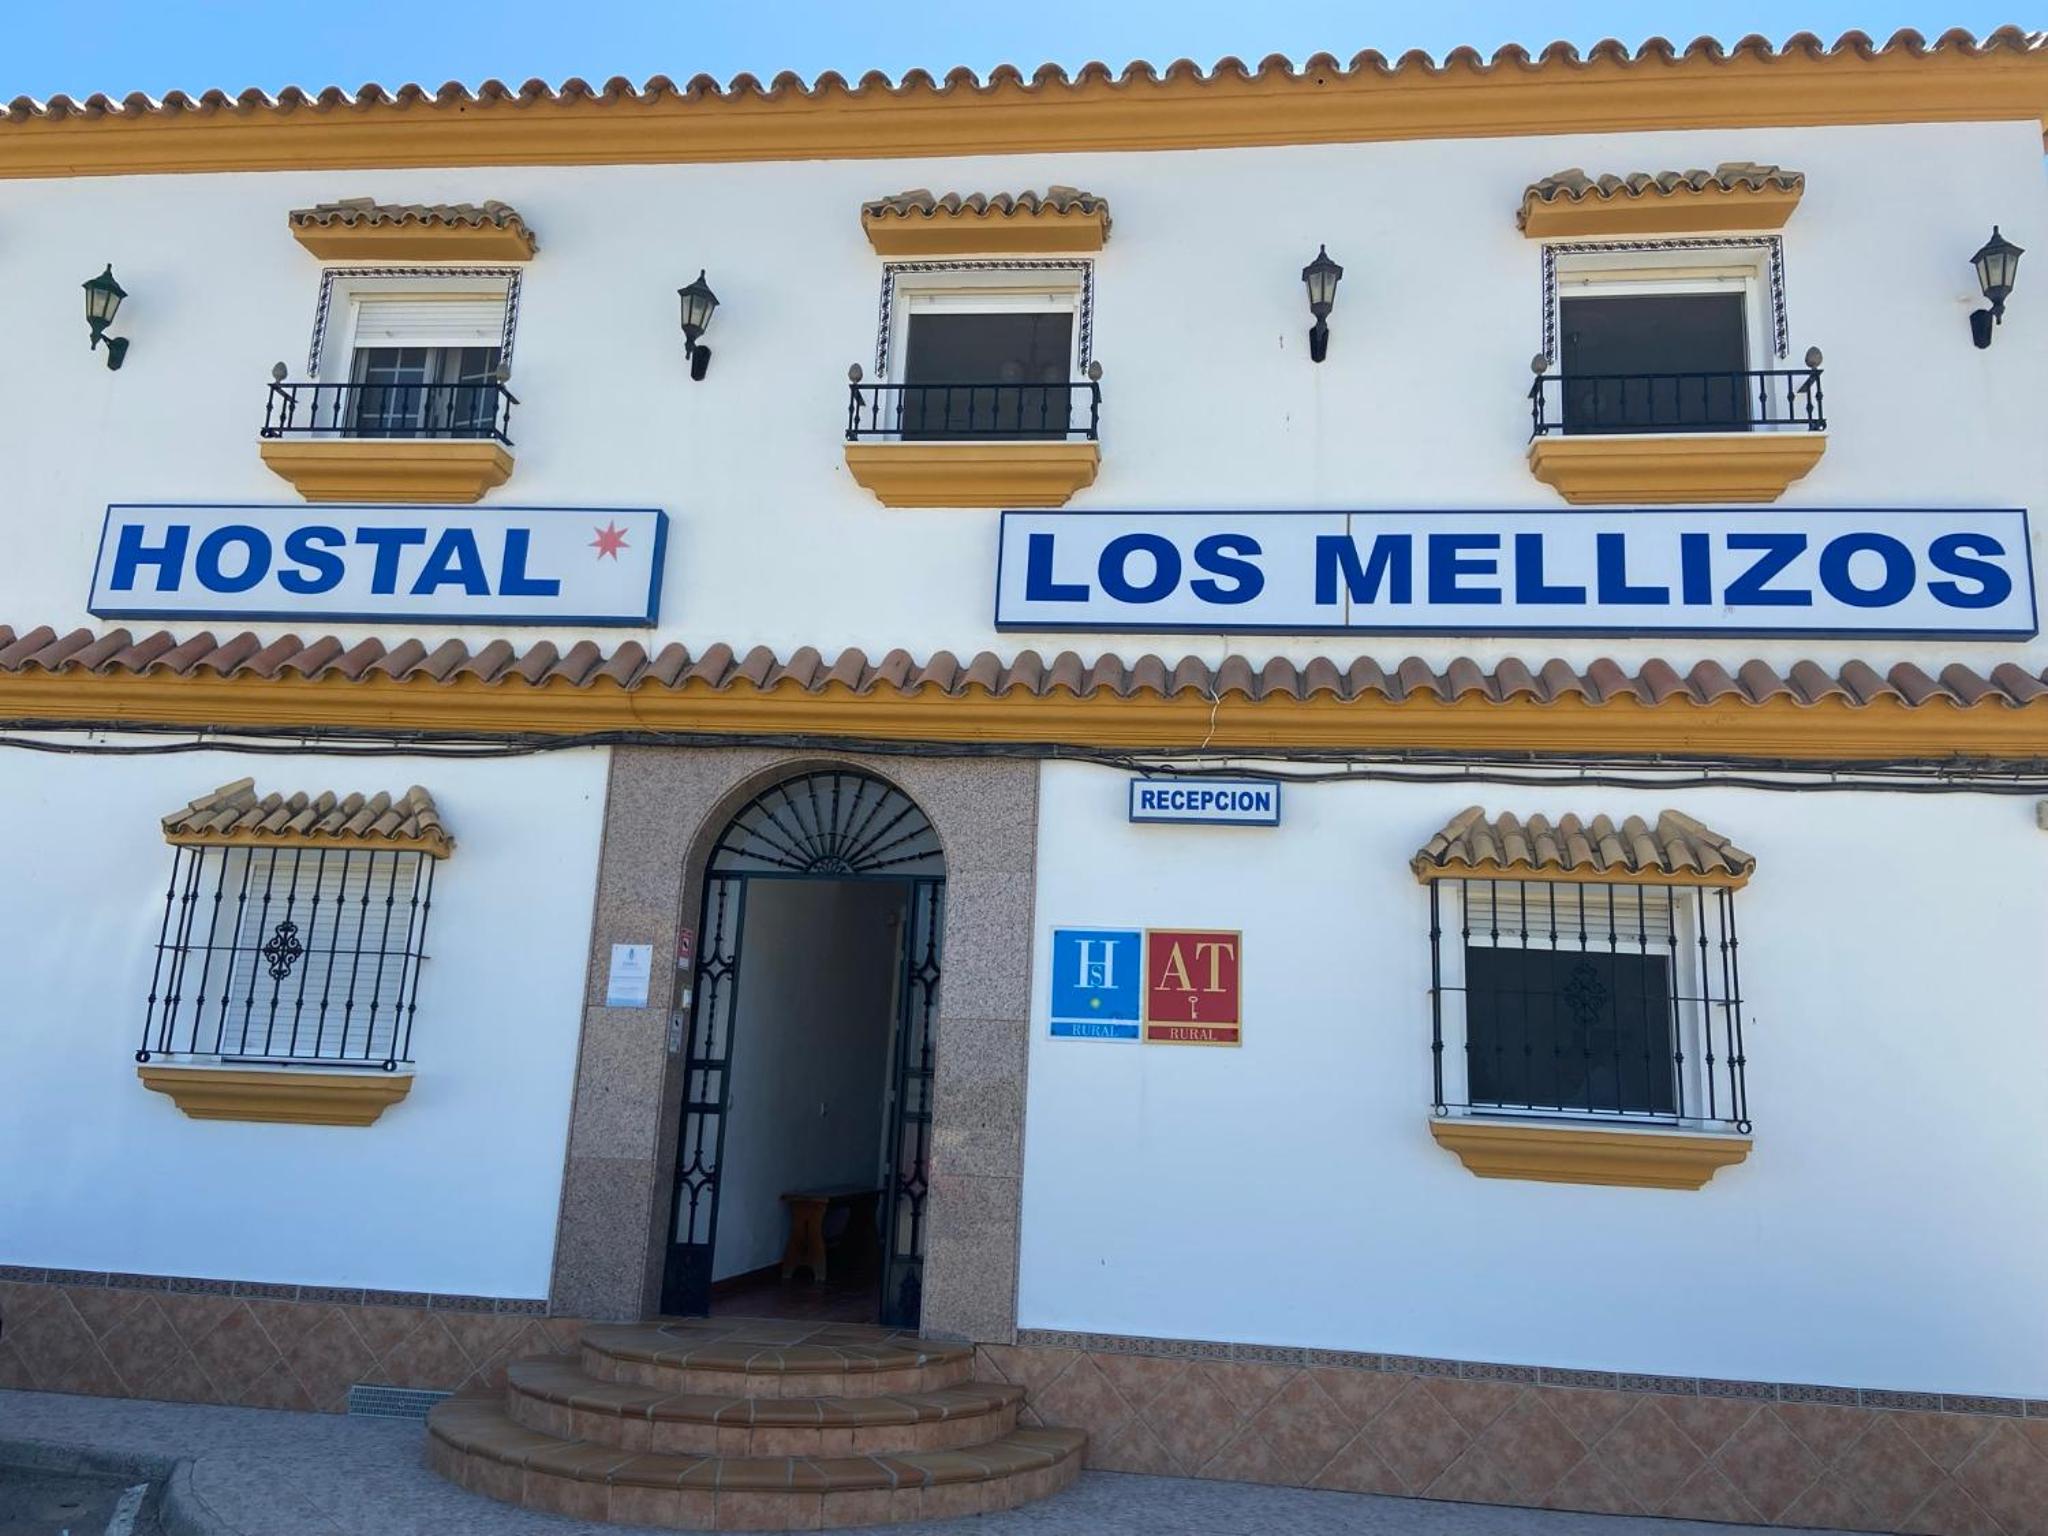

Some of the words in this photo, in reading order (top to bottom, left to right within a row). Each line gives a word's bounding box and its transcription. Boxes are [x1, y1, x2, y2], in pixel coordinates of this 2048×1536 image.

[109, 525, 562, 597] HOSTAL
[1025, 532, 1265, 606] LOS
[1314, 532, 2015, 609] MELLIZOS
[1141, 790, 1271, 812] RECEPCION
[1154, 941, 1235, 992] AT
[1072, 1023, 1118, 1037] RURAL
[1169, 1027, 1217, 1041] RURAL
